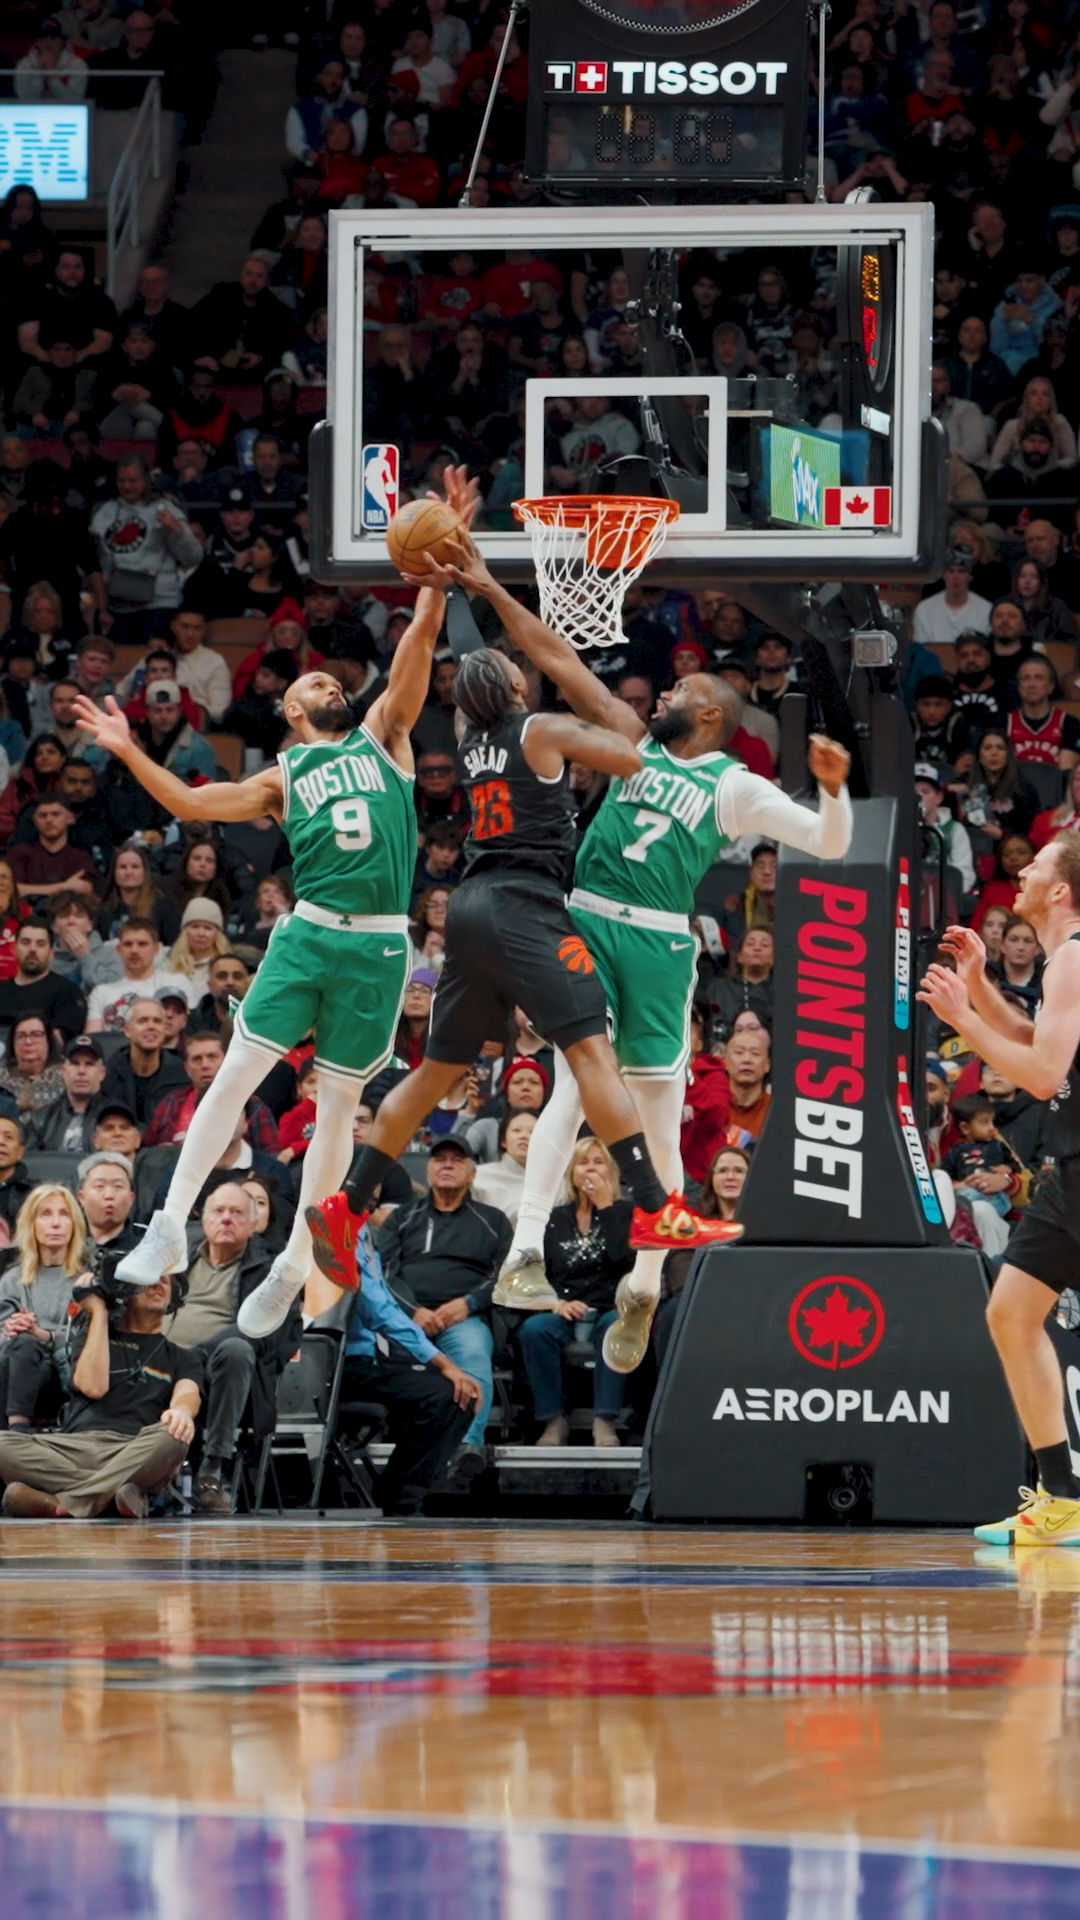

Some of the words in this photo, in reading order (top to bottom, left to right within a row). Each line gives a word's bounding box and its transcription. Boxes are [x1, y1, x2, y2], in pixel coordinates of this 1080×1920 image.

[613, 61, 788, 95] TISSOT
[366, 509, 385, 524] NBA
[293, 753, 387, 818] BOSTON
[463, 745, 508, 778] SHEAD
[331, 797, 372, 850] 9
[471, 779, 515, 840] 23
[622, 808, 673, 862] 7
[793, 877, 868, 1219] POINTSBET
[712, 1388, 950, 1423] AEROPLAN
